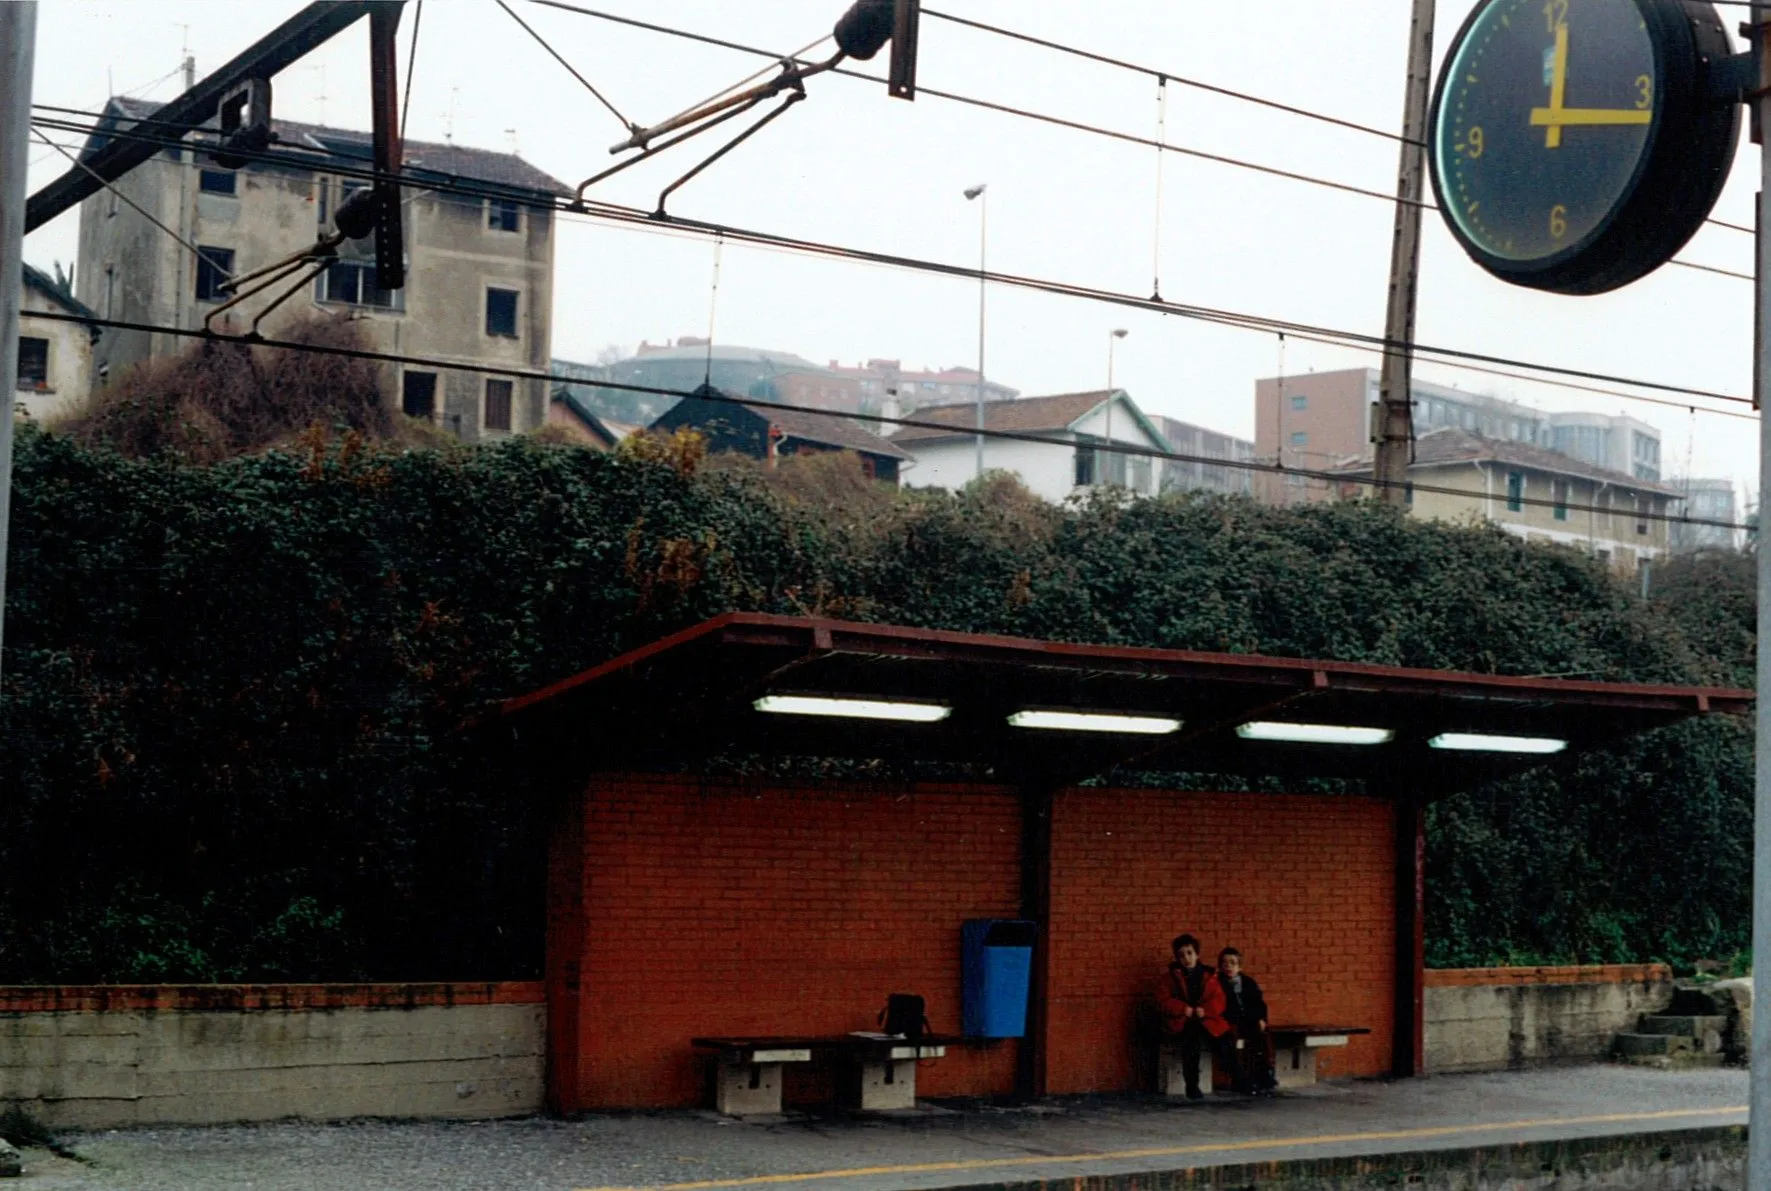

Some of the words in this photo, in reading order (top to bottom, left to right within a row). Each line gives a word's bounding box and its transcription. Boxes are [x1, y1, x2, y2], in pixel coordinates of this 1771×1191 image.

[1542, 0, 1568, 33] 12
[1634, 74, 1651, 109] 3
[1467, 126, 1484, 159] 9
[1550, 204, 1567, 238] 6
